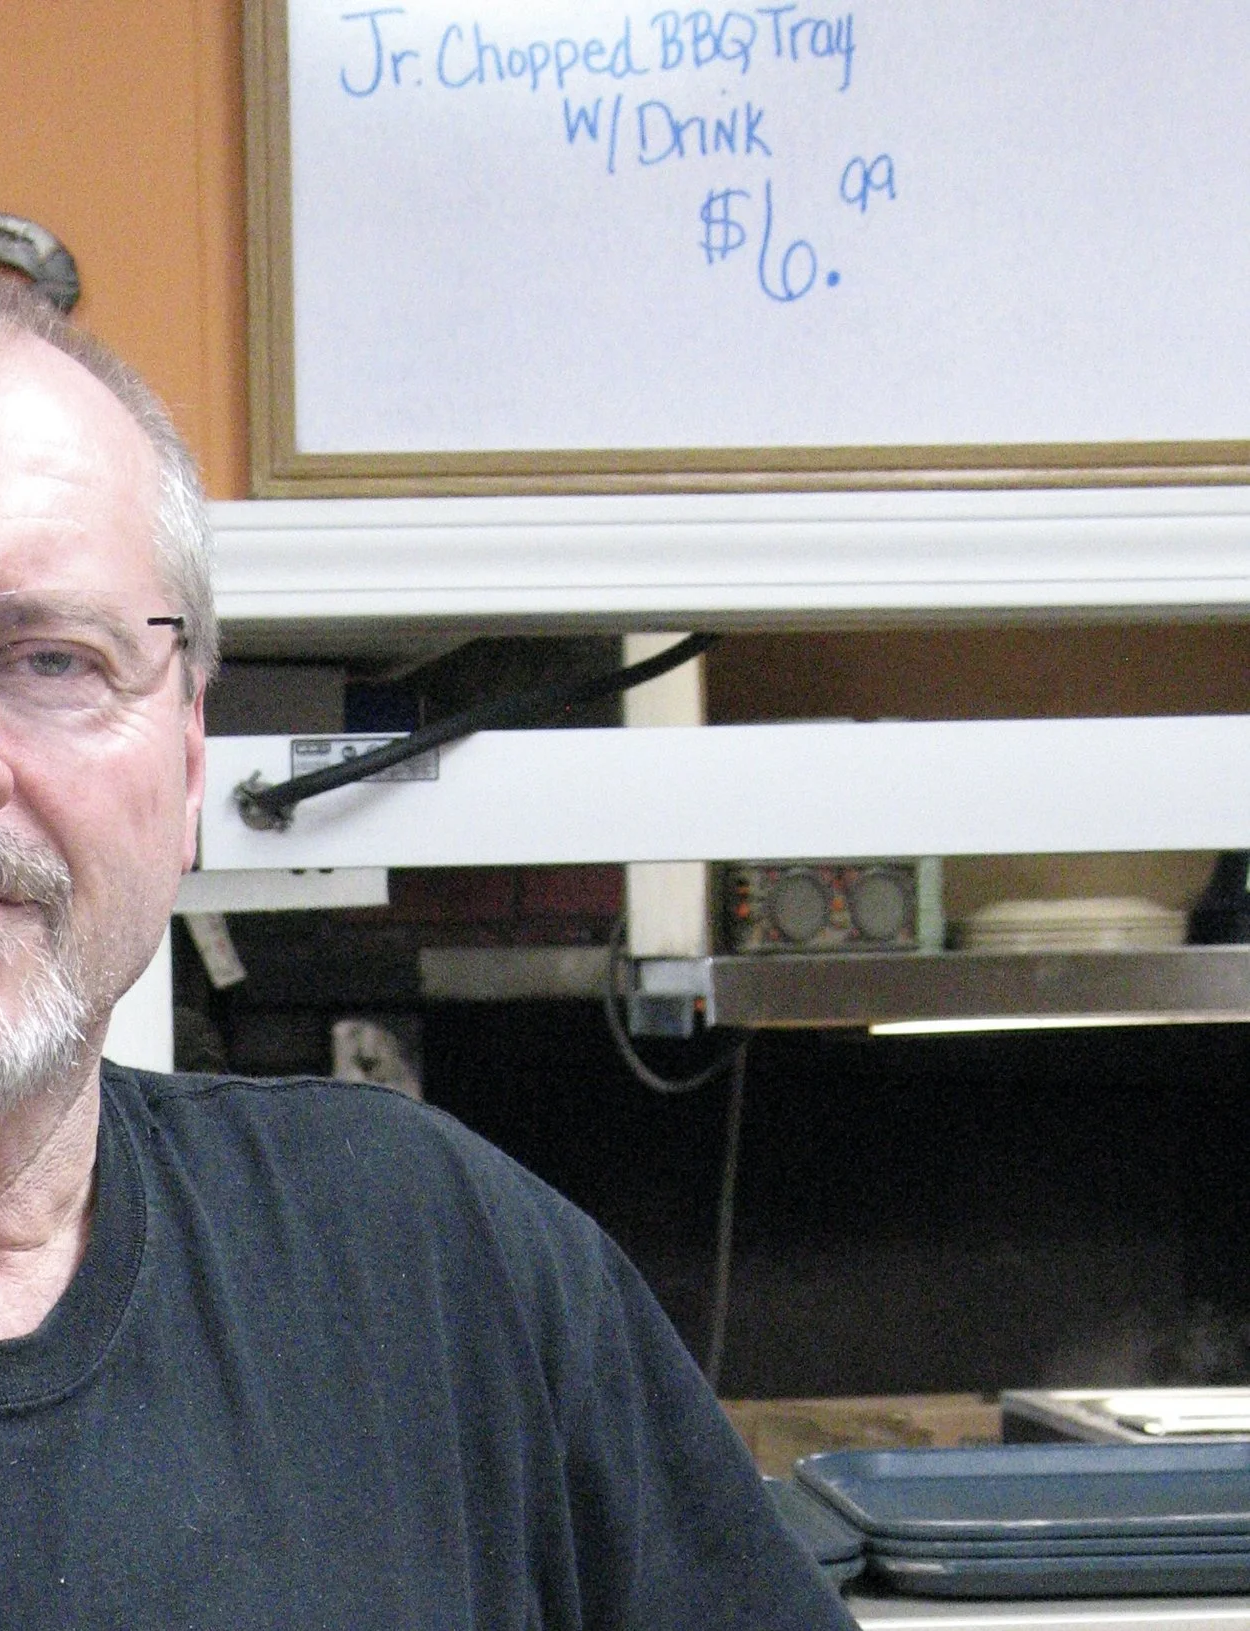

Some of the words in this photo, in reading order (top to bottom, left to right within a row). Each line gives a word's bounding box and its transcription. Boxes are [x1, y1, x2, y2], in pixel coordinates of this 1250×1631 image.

[340, 8, 423, 98] Jr.
[437, 15, 650, 92] Chopped
[650, 10, 758, 75] BBQ
[755, 4, 856, 92] Tray
